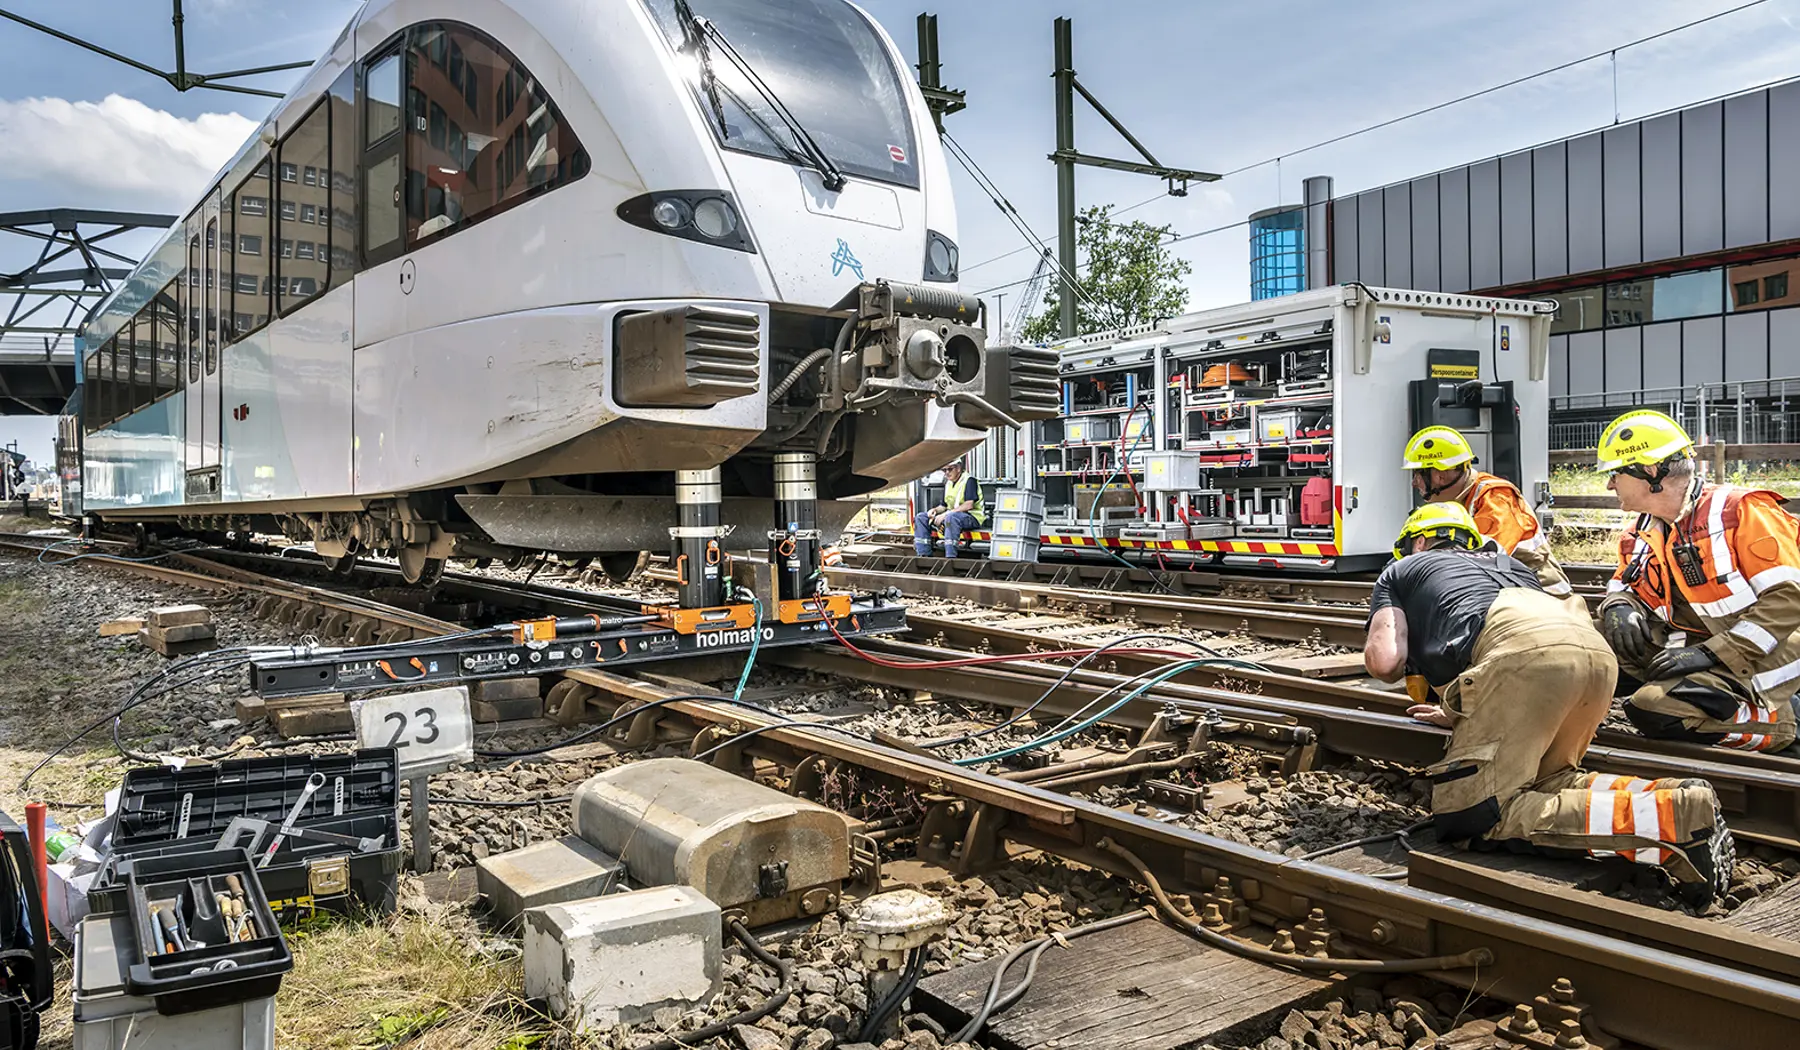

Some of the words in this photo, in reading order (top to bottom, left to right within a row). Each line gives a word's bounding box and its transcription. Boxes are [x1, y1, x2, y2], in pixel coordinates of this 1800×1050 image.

[1615, 442, 1649, 456] ProRail
[1417, 452, 1443, 461] ProRail
[590, 617, 623, 626] hlmatro
[384, 707, 440, 749] 23
